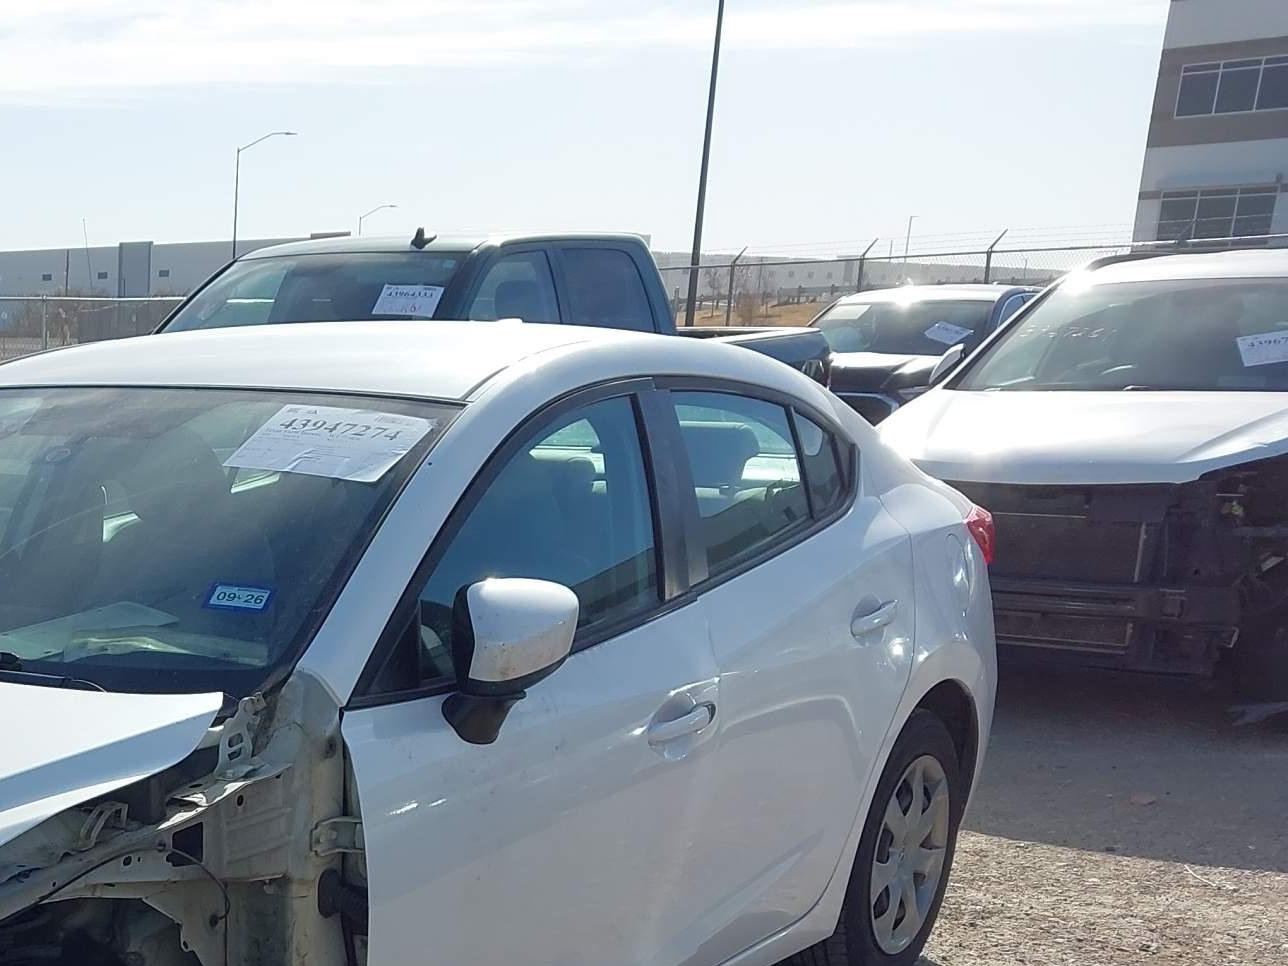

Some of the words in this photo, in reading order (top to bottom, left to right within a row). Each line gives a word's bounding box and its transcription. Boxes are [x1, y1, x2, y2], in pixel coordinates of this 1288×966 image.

[279, 417, 403, 442] 43947274
[216, 591, 237, 602] 09
[243, 593, 265, 605] 26
